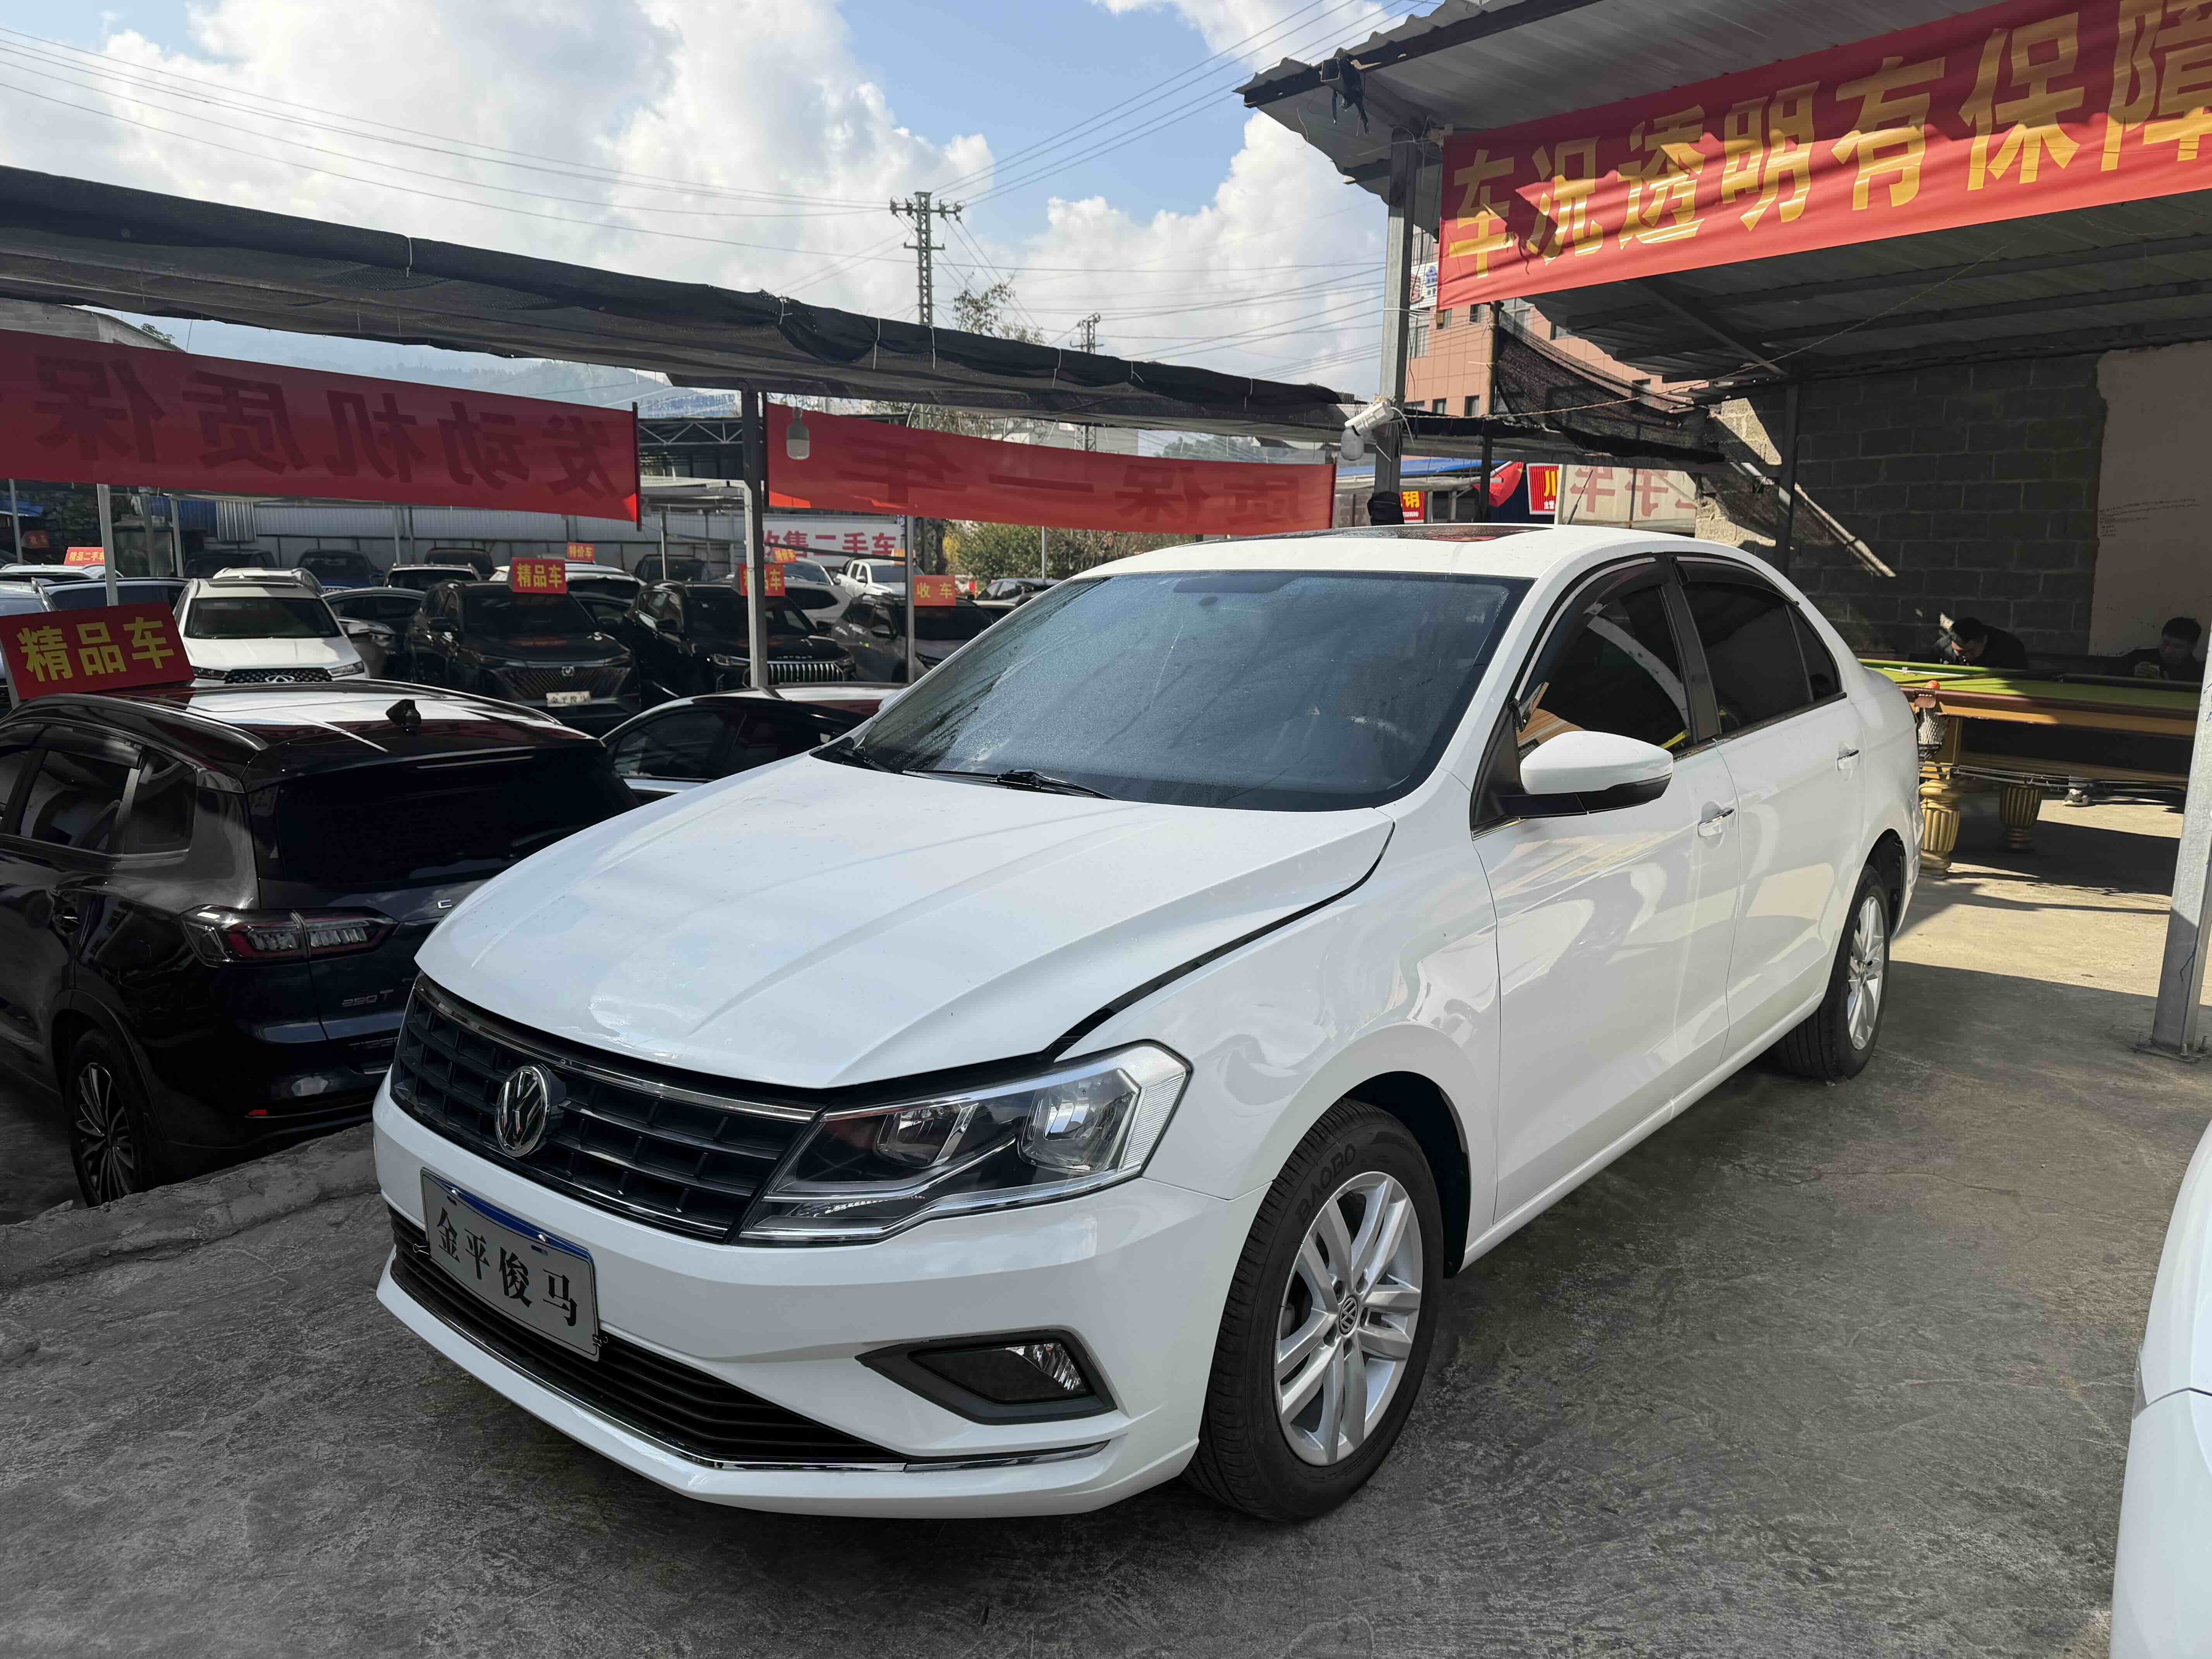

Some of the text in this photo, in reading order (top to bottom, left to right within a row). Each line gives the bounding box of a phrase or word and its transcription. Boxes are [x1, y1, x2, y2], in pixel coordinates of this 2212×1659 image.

[1449, 0, 2212, 279] 车况透明有保障
[517, 563, 562, 588] 精品车
[917, 582, 953, 599] 收车
[17, 616, 175, 682] 精品车
[437, 1206, 577, 1326] 金平俊马
